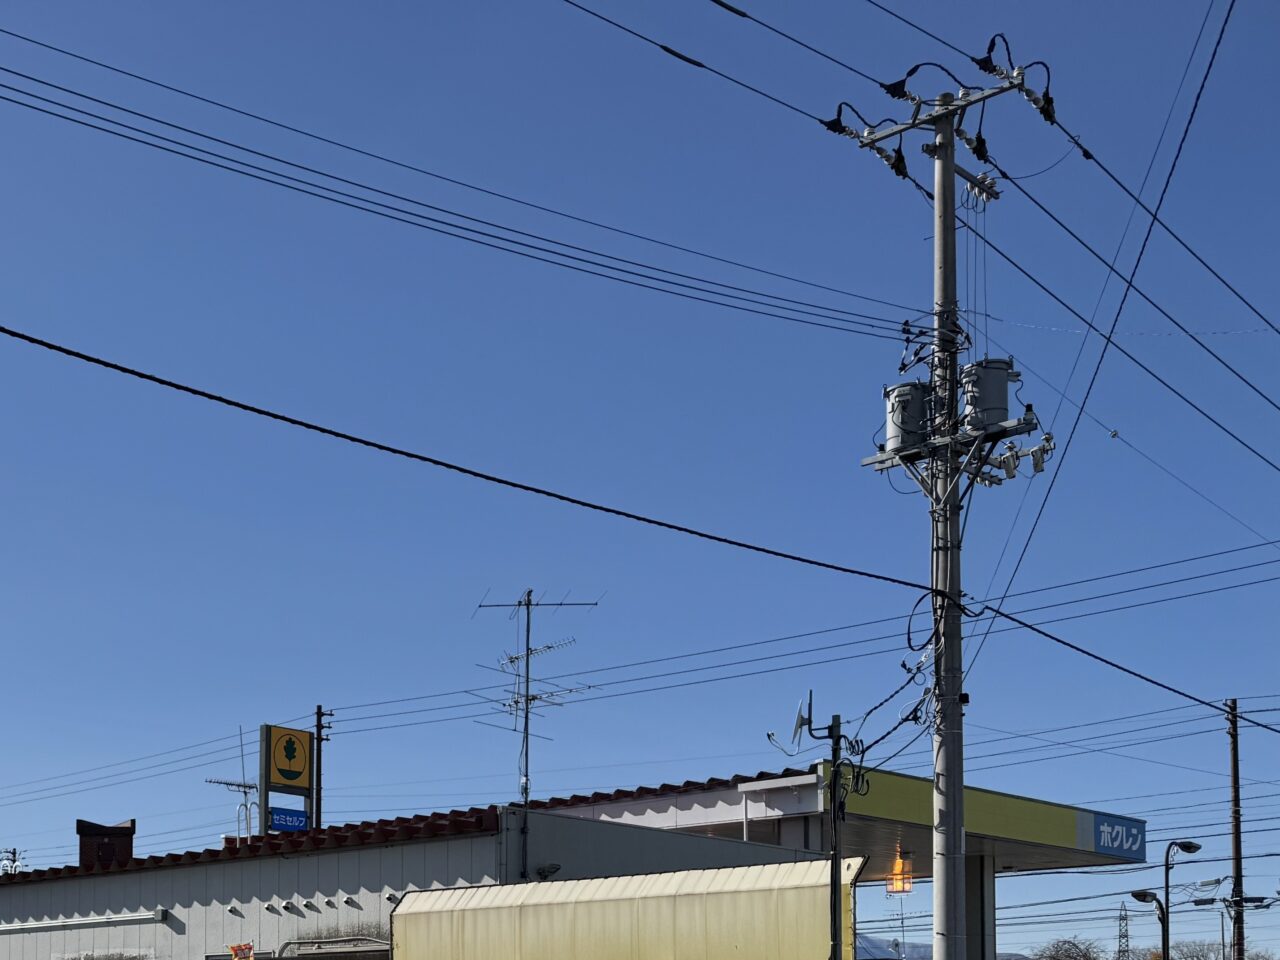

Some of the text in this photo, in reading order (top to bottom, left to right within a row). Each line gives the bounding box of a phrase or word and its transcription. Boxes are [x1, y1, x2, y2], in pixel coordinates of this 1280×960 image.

[273, 813, 306, 827] セミセルフ
[1100, 822, 1142, 851] ホクレン
